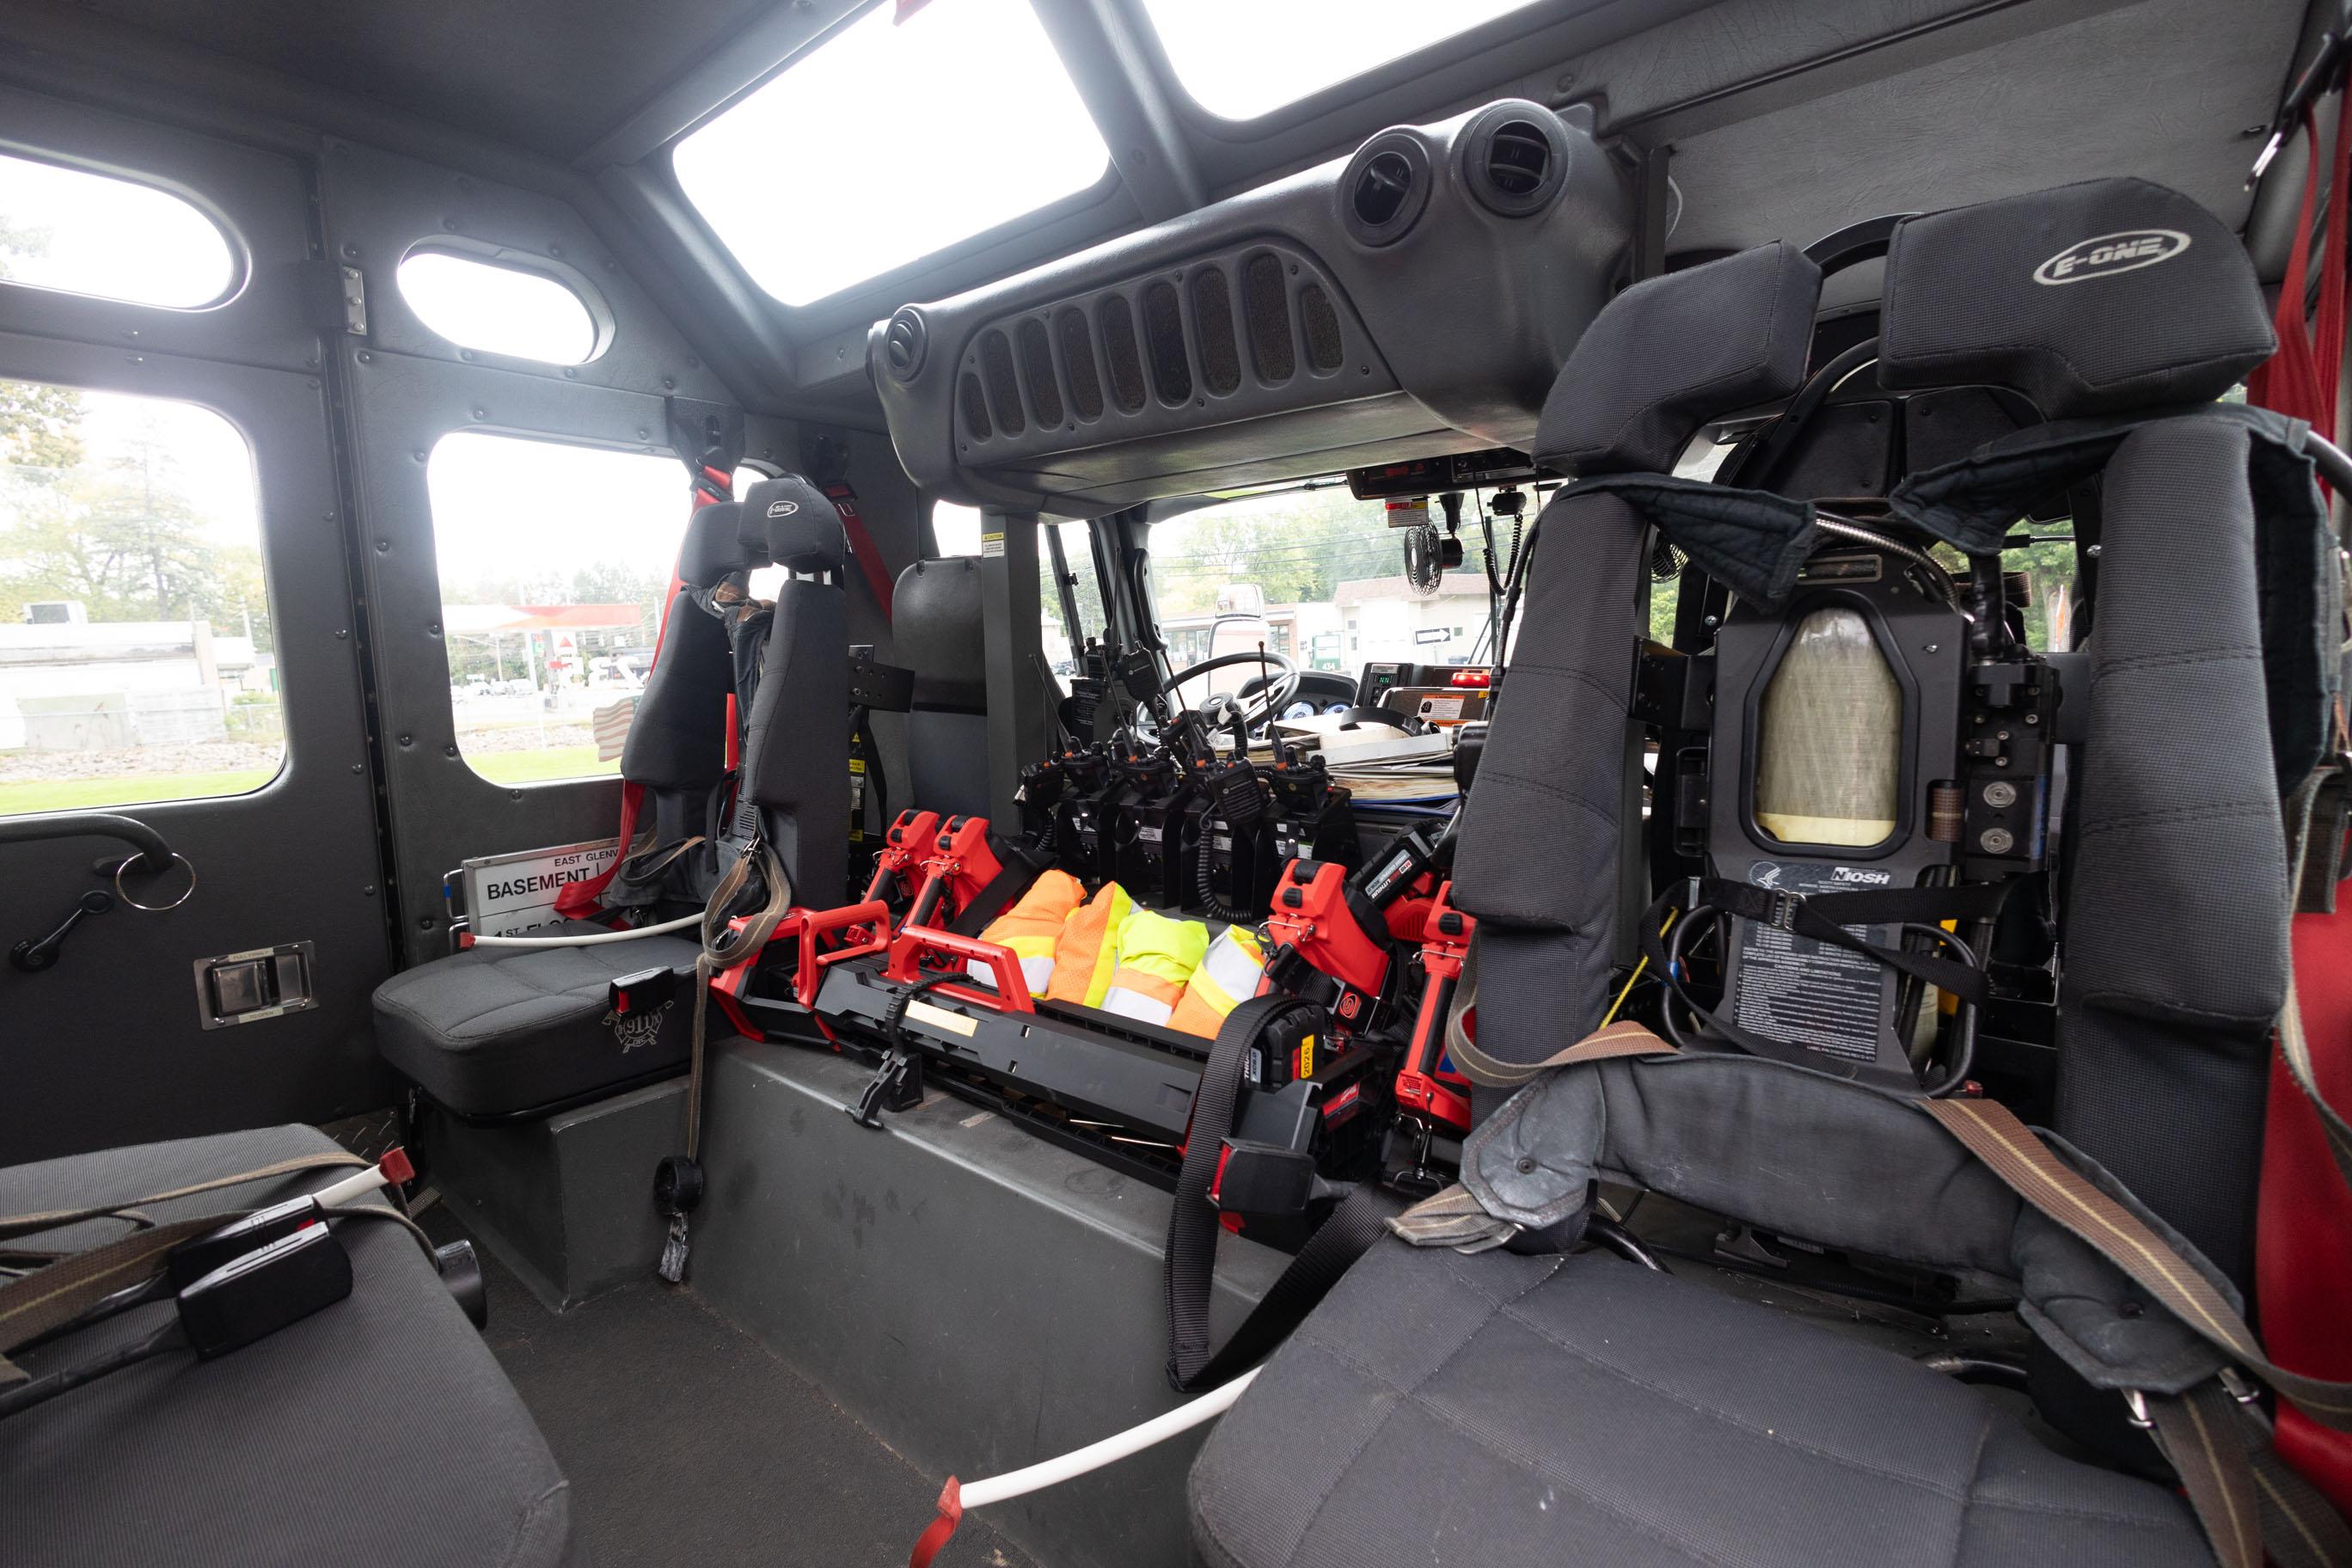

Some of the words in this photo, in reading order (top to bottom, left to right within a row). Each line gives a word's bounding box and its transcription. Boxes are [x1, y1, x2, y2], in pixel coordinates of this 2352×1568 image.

[2052, 236, 2165, 279] E-ONE
[554, 855, 581, 867] EAST
[585, 848, 619, 862] GLENV
[487, 867, 591, 900] BASEMENT
[1832, 868, 1890, 885] NIOSH
[627, 1015, 652, 1034] 911
